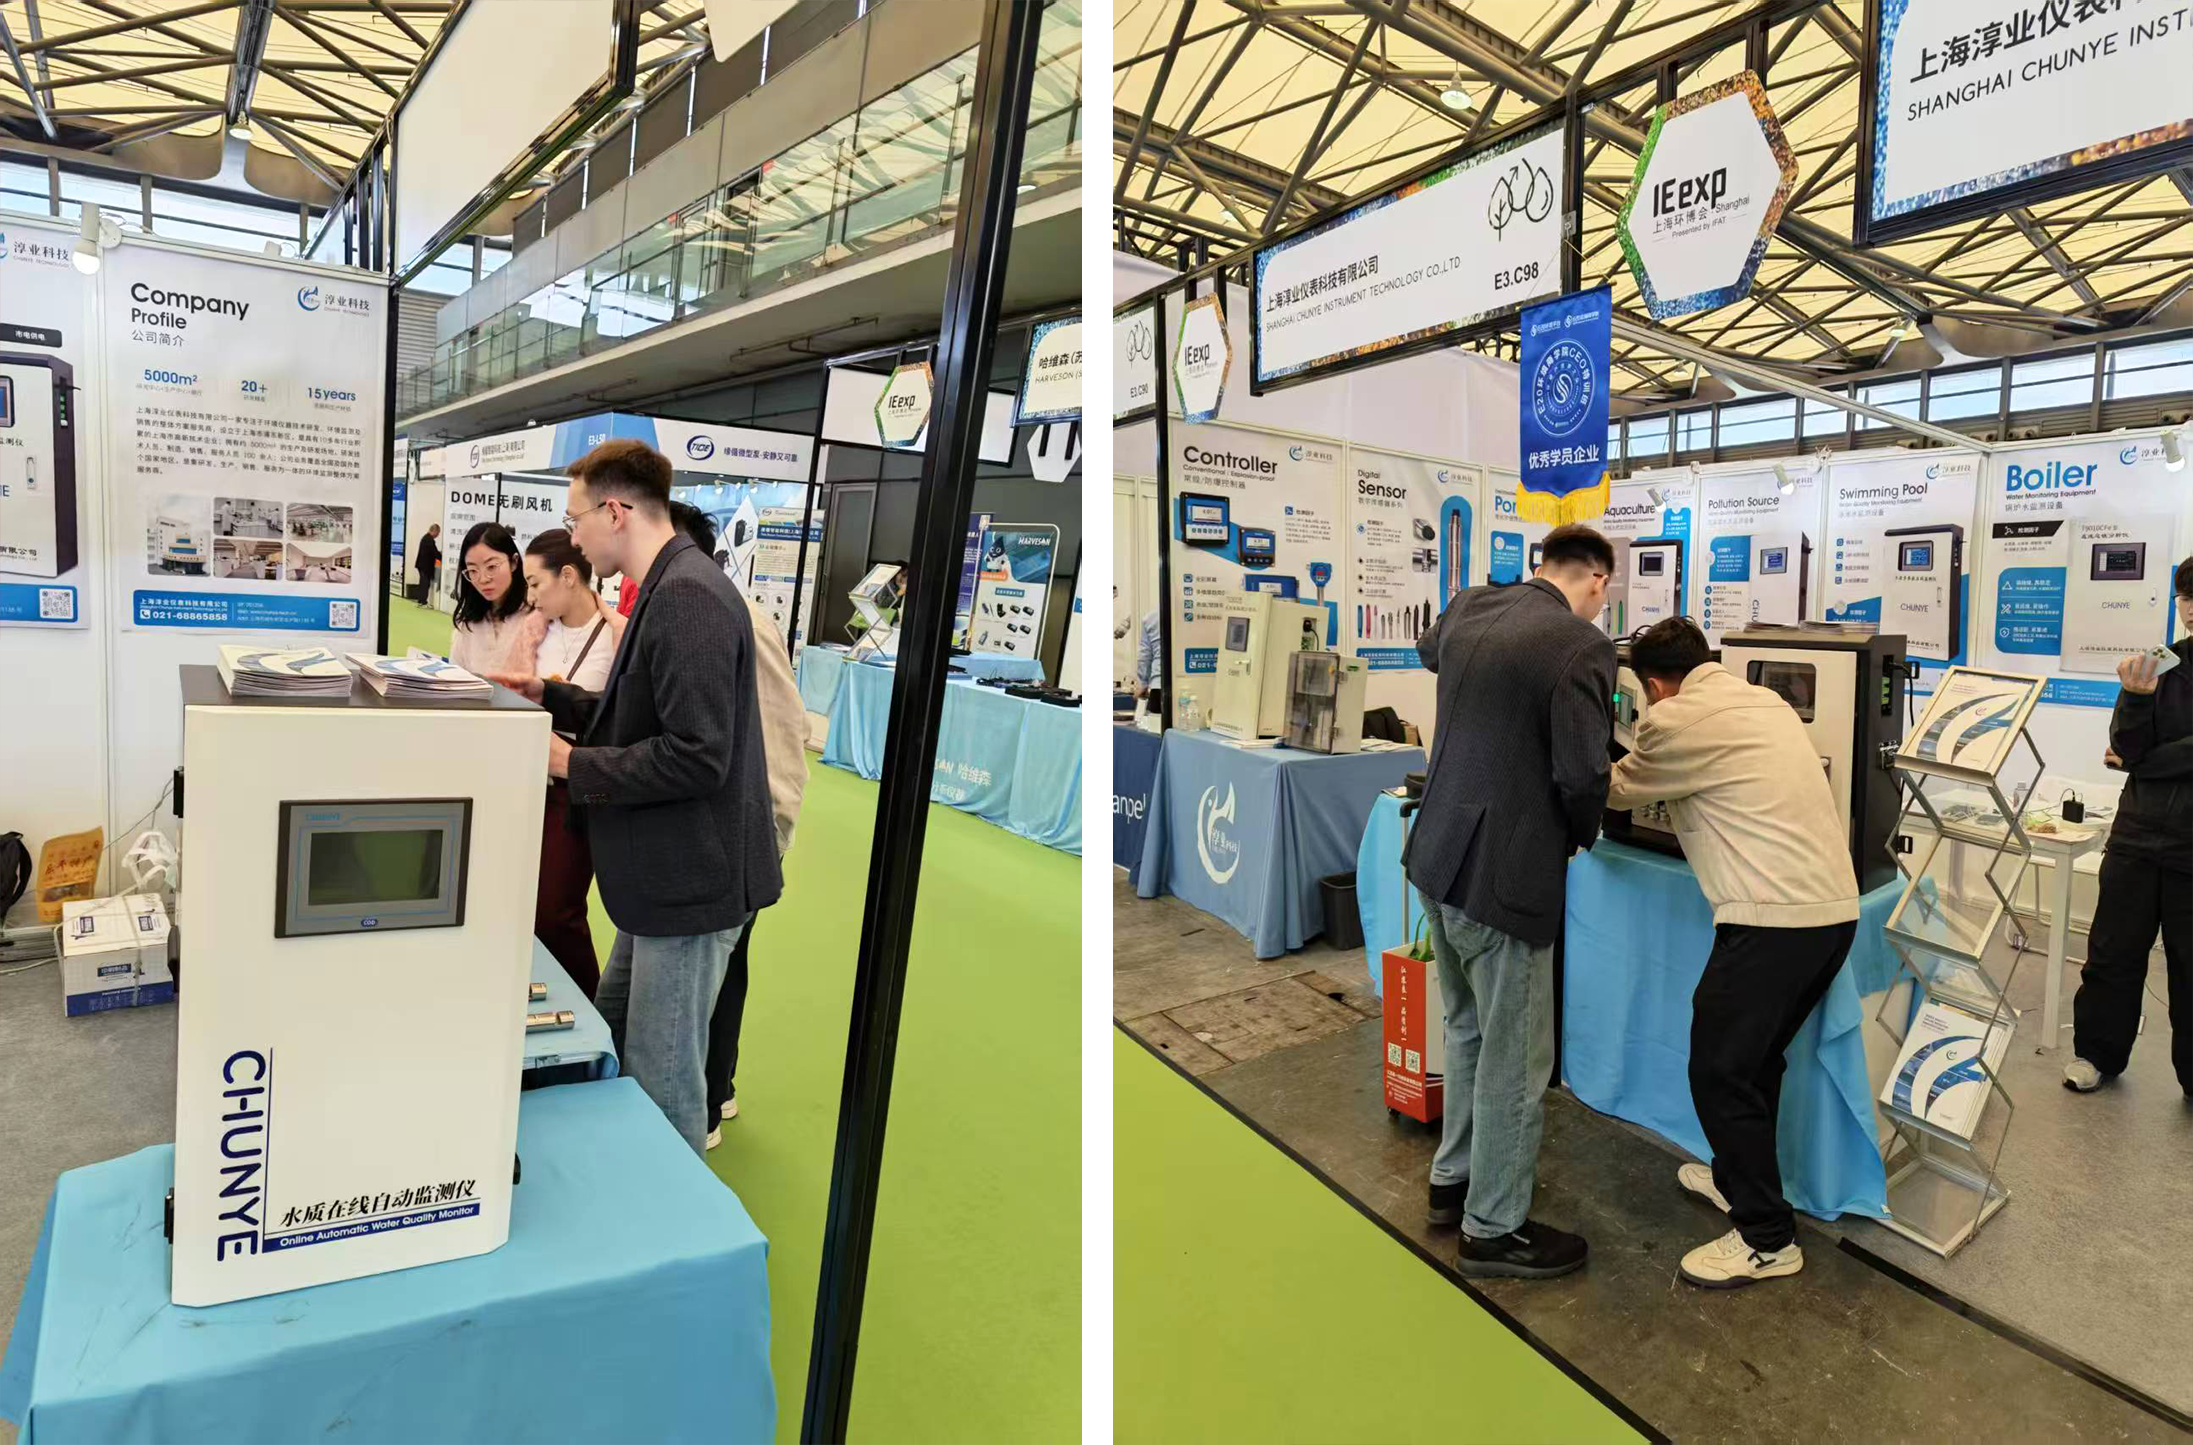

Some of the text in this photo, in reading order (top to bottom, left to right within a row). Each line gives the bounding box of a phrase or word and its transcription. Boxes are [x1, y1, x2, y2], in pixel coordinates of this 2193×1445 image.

[1906, 8, 2193, 122] SHANGHAI CHUNYE INST
[1653, 167, 1727, 218] IEexp
[1652, 206, 1708, 235] 上海环博会
[1672, 216, 1726, 238] Presented by IFAT
[13, 241, 69, 261] 淳业科技
[1266, 255, 1540, 313] 上海淳业仪表科技有限公司 E3.C98
[131, 282, 249, 321] Company
[325, 293, 369, 311] 淳业科技
[1266, 315, 1296, 332] SHANGHAI
[1296, 305, 1322, 322] CHUNYE
[1323, 289, 1367, 313] INSTRUMENT
[1369, 269, 1424, 297] TECHNOLOGY
[131, 307, 187, 330] Profile
[131, 329, 185, 347] 公司简介
[1183, 446, 1278, 475] Controller
[1528, 444, 1600, 470] 优秀学员企业
[1183, 464, 1226, 476] Conventional
[1358, 469, 1381, 479] Digital
[2006, 461, 2098, 492] Boiler
[1358, 480, 1407, 500] Sensor
[1840, 483, 1928, 500] Swimming Pool
[2025, 491, 2059, 500] Monitoring
[2060, 489, 2097, 498] Equipment
[1604, 504, 1655, 517] Aquaculture
[1709, 496, 1779, 509] Pollution Source
[217, 1050, 267, 1262] CHUNYE
[280, 1179, 476, 1228] 水质在线自动监测仪
[280, 1206, 474, 1247] Online Automatic Water Quality Monitor
